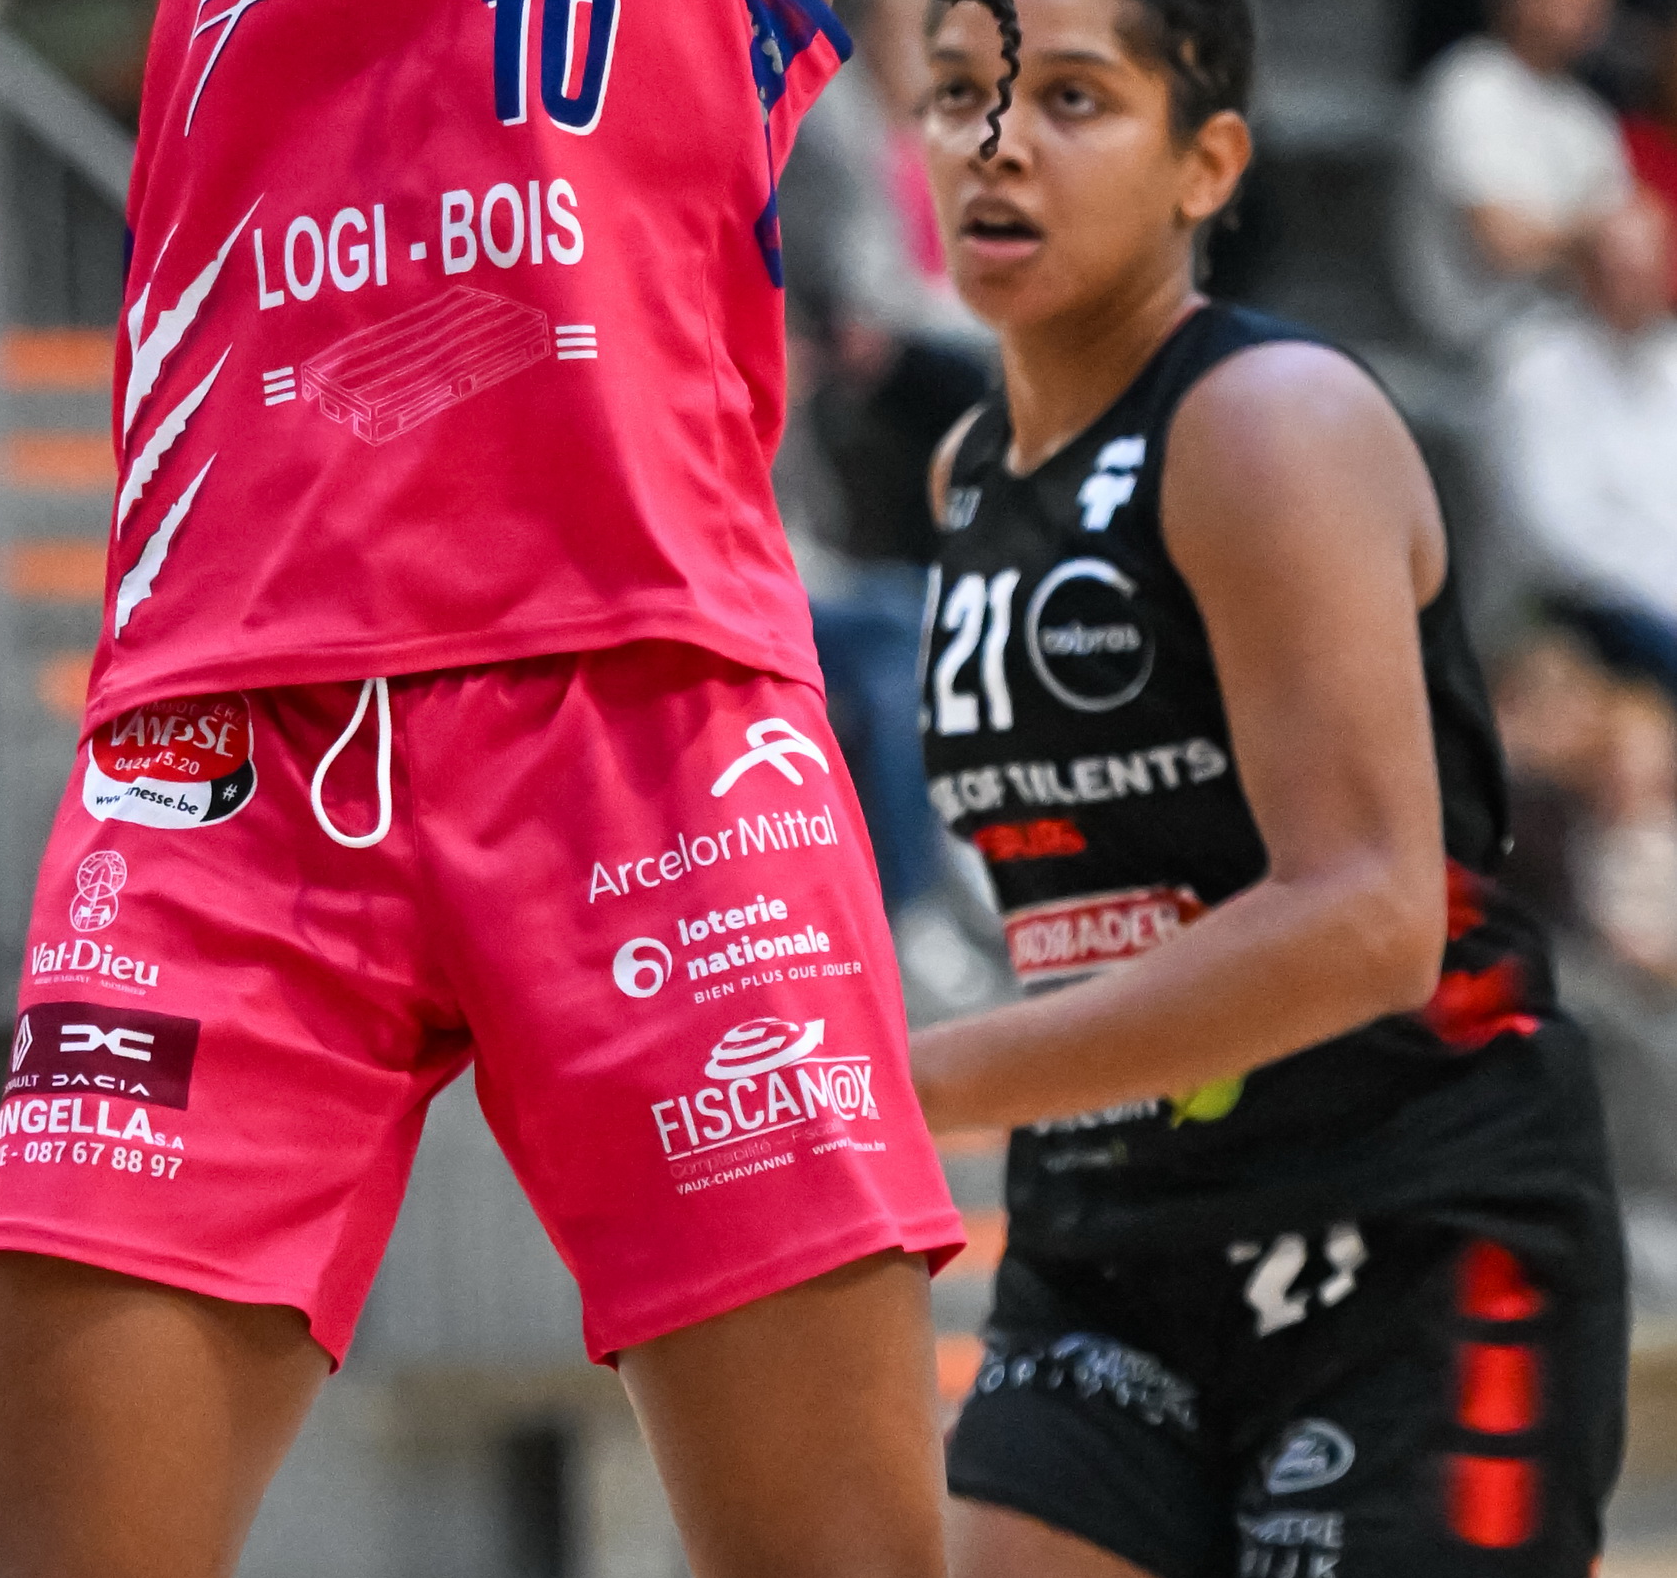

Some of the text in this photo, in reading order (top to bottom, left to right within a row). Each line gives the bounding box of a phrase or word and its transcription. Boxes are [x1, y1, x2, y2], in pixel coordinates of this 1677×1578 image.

[253, 204, 388, 310] LOGI
[440, 178, 585, 275] BOIS
[932, 566, 1022, 737] 21
[588, 804, 839, 904] ArcelorMittal
[677, 894, 788, 947] loterie
[31, 938, 160, 988] Val-Dieu
[686, 924, 831, 981] nationale
[694, 960, 863, 1004] BIEN PLUS QUE JOUER
[651, 1063, 878, 1155] FISCAM@X
[24, 1140, 66, 1164] 087
[73, 1140, 106, 1166] 67
[111, 1145, 144, 1173] 88
[150, 1153, 184, 1180] 97
[675, 1151, 796, 1197] VAUX-CHAVANNE
